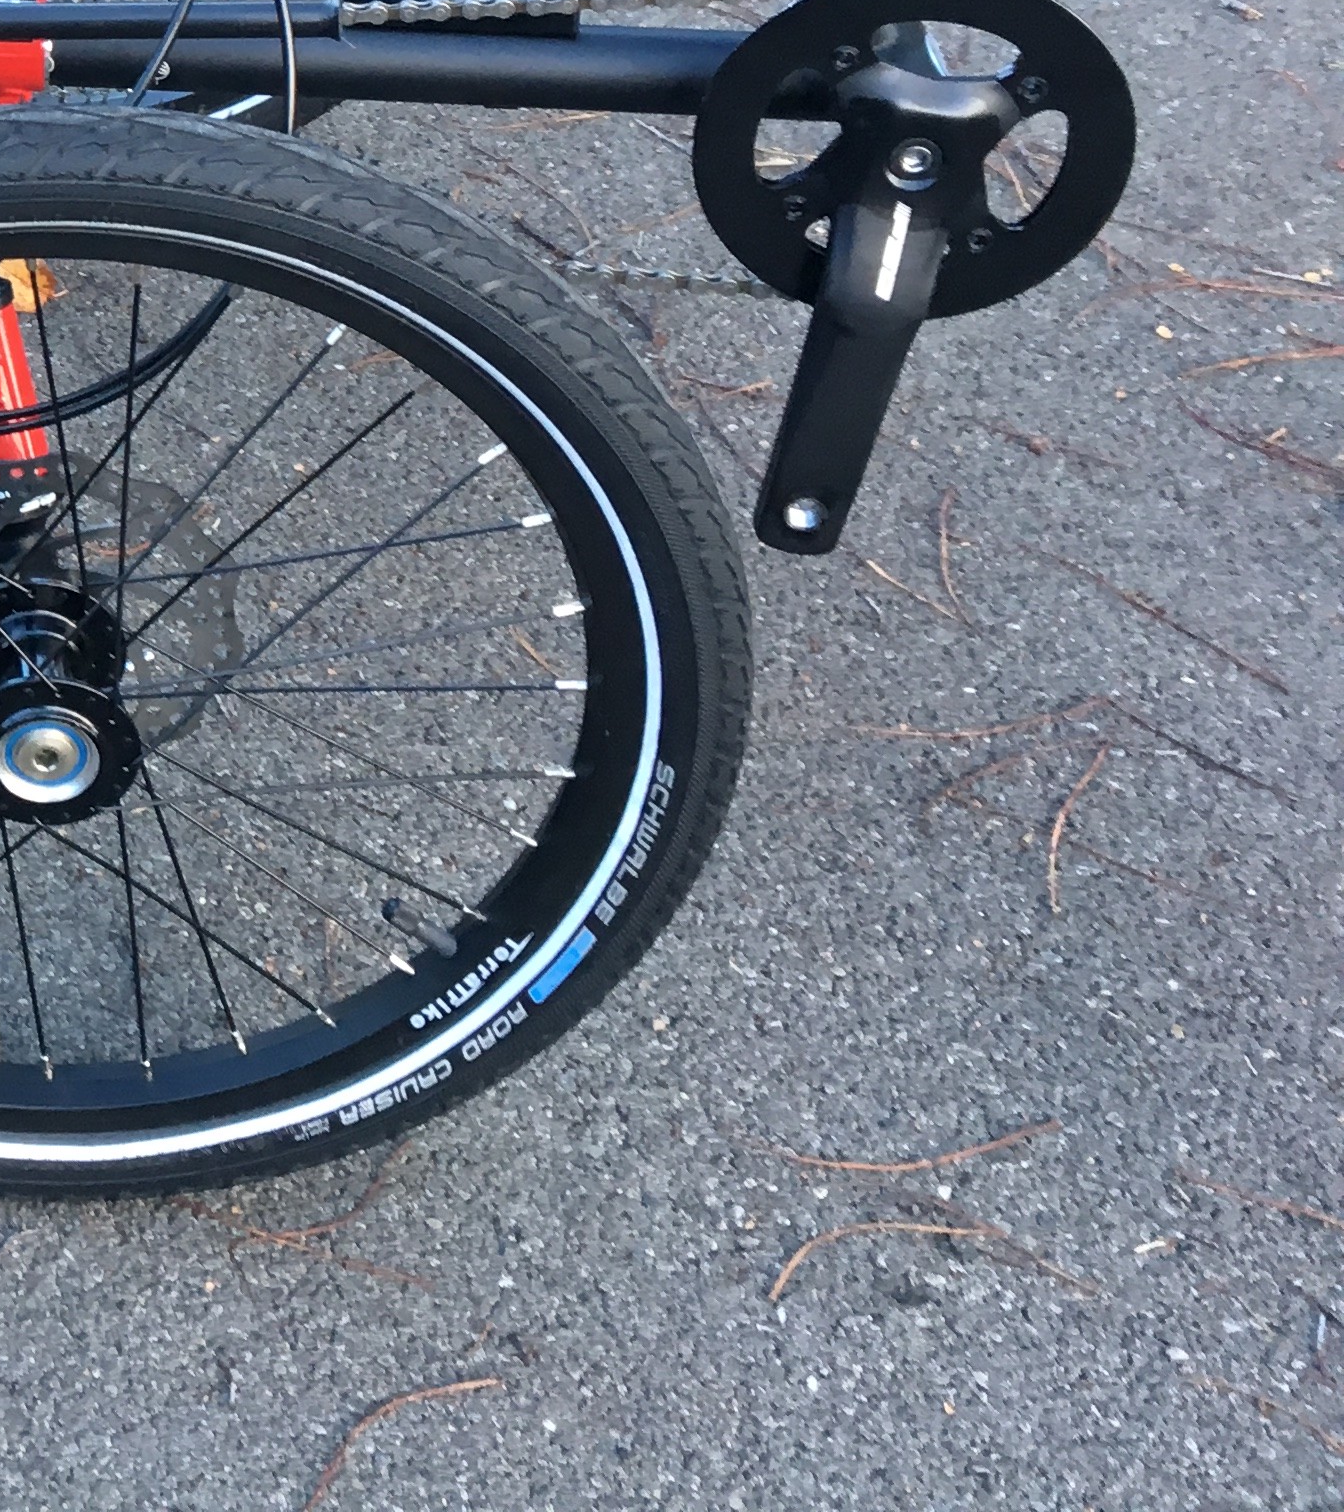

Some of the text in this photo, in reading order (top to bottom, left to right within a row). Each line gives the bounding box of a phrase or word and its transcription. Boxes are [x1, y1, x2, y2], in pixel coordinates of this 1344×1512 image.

[338, 759, 675, 1126] SCHWALBE ROAD CRUISER
[409, 931, 534, 1029] TerraTrike
